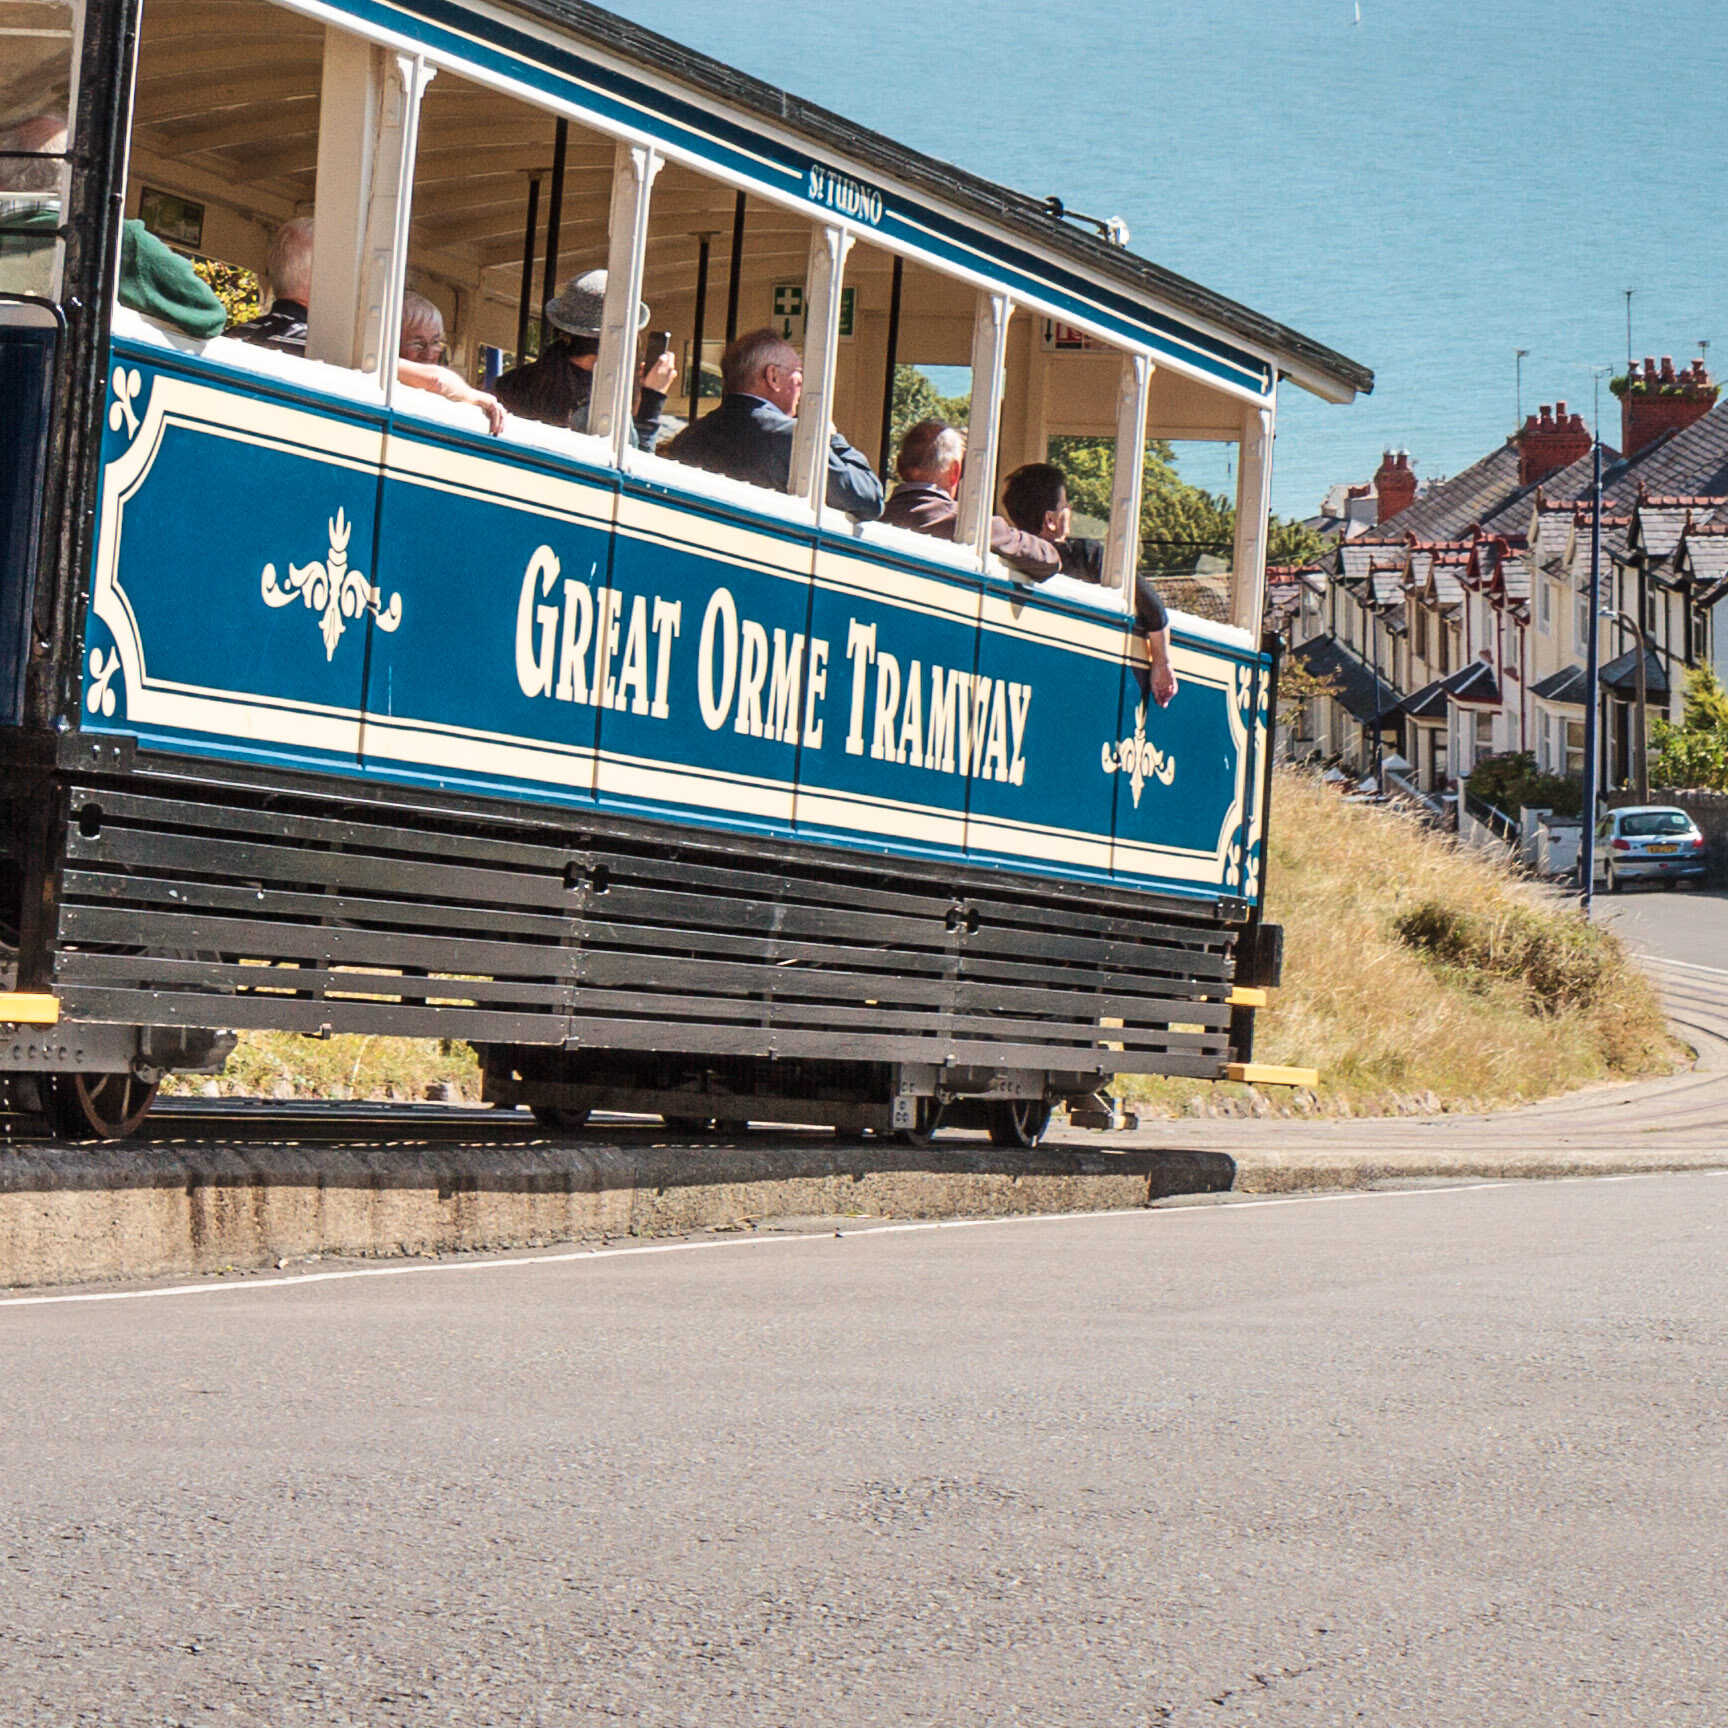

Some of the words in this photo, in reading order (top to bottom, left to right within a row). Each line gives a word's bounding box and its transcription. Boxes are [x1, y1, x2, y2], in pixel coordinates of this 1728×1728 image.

[825, 170, 883, 226] TUDNO
[515, 544, 682, 719] GREAT
[697, 587, 830, 750] ORME
[845, 617, 1032, 787] TRAMWAY
